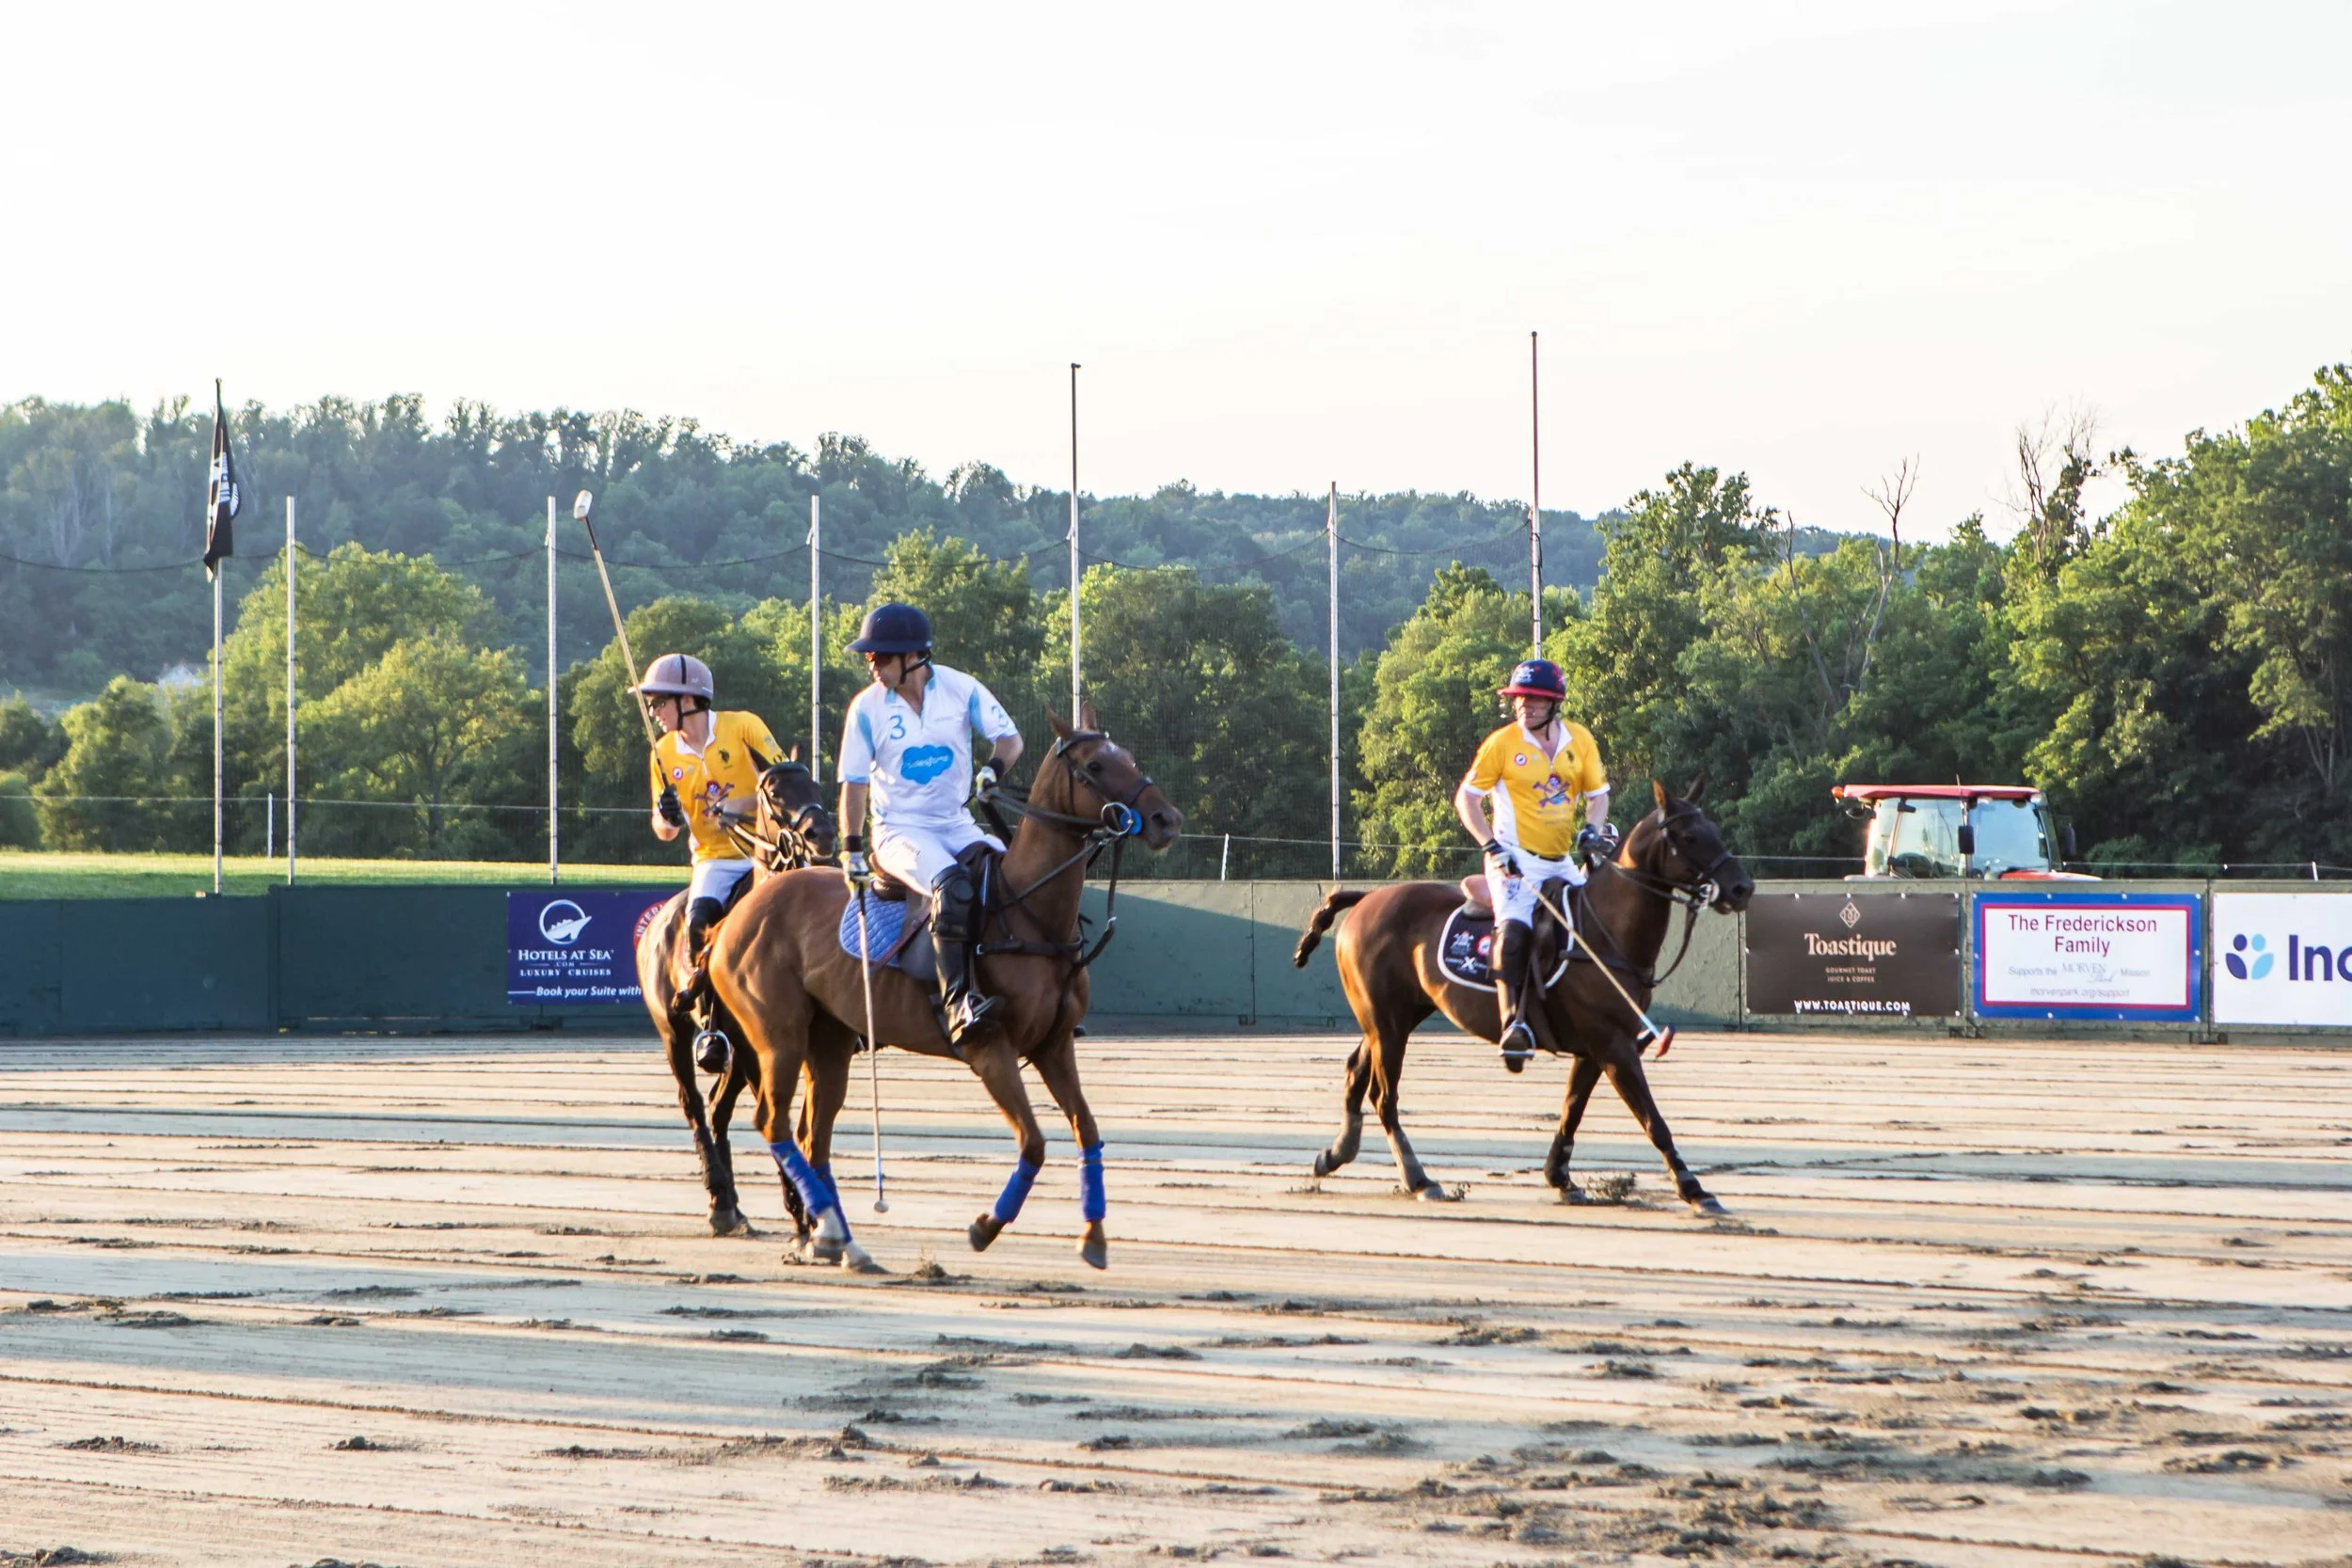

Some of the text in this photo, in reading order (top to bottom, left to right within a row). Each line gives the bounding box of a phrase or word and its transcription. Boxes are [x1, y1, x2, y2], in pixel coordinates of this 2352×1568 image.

[889, 715, 906, 739] 3
[2008, 914, 2157, 932] The Frederickson
[518, 949, 567, 960] HOTELS
[1804, 933, 1898, 961] Toastique
[2054, 936, 2110, 958] Family
[2009, 966, 2043, 976] Supports
[2044, 967, 2058, 976] the
[2061, 962, 2107, 974] MORVEN
[536, 986, 642, 998] Book your Suite with
[1793, 1000, 1911, 1012] WWW.TOASTIQUE.COM
